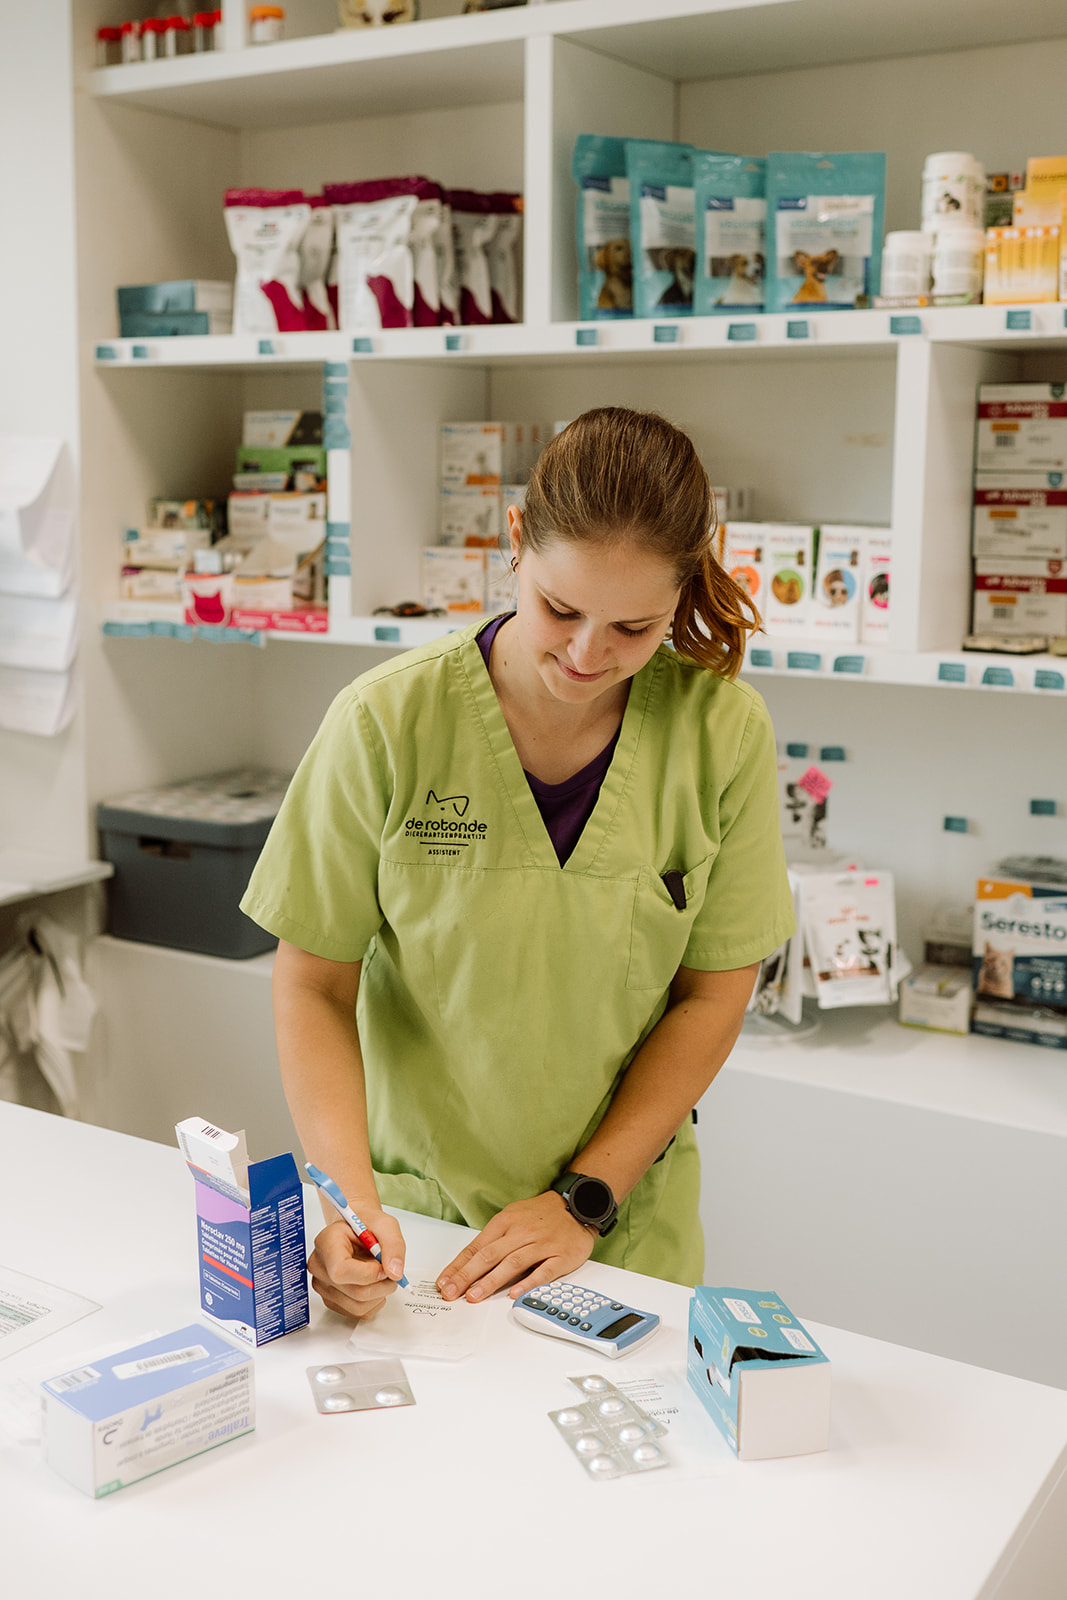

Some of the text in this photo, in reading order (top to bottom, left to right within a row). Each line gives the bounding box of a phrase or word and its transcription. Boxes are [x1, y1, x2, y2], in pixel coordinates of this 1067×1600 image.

[405, 817, 488, 832] de rotonde
[405, 831, 486, 839] DIERENARTSENPRAKTIJK
[981, 911, 1067, 941] Seresto
[200, 1219, 246, 1255] Noroclav 250 mg
[207, 1415, 249, 1442] Tralieve
